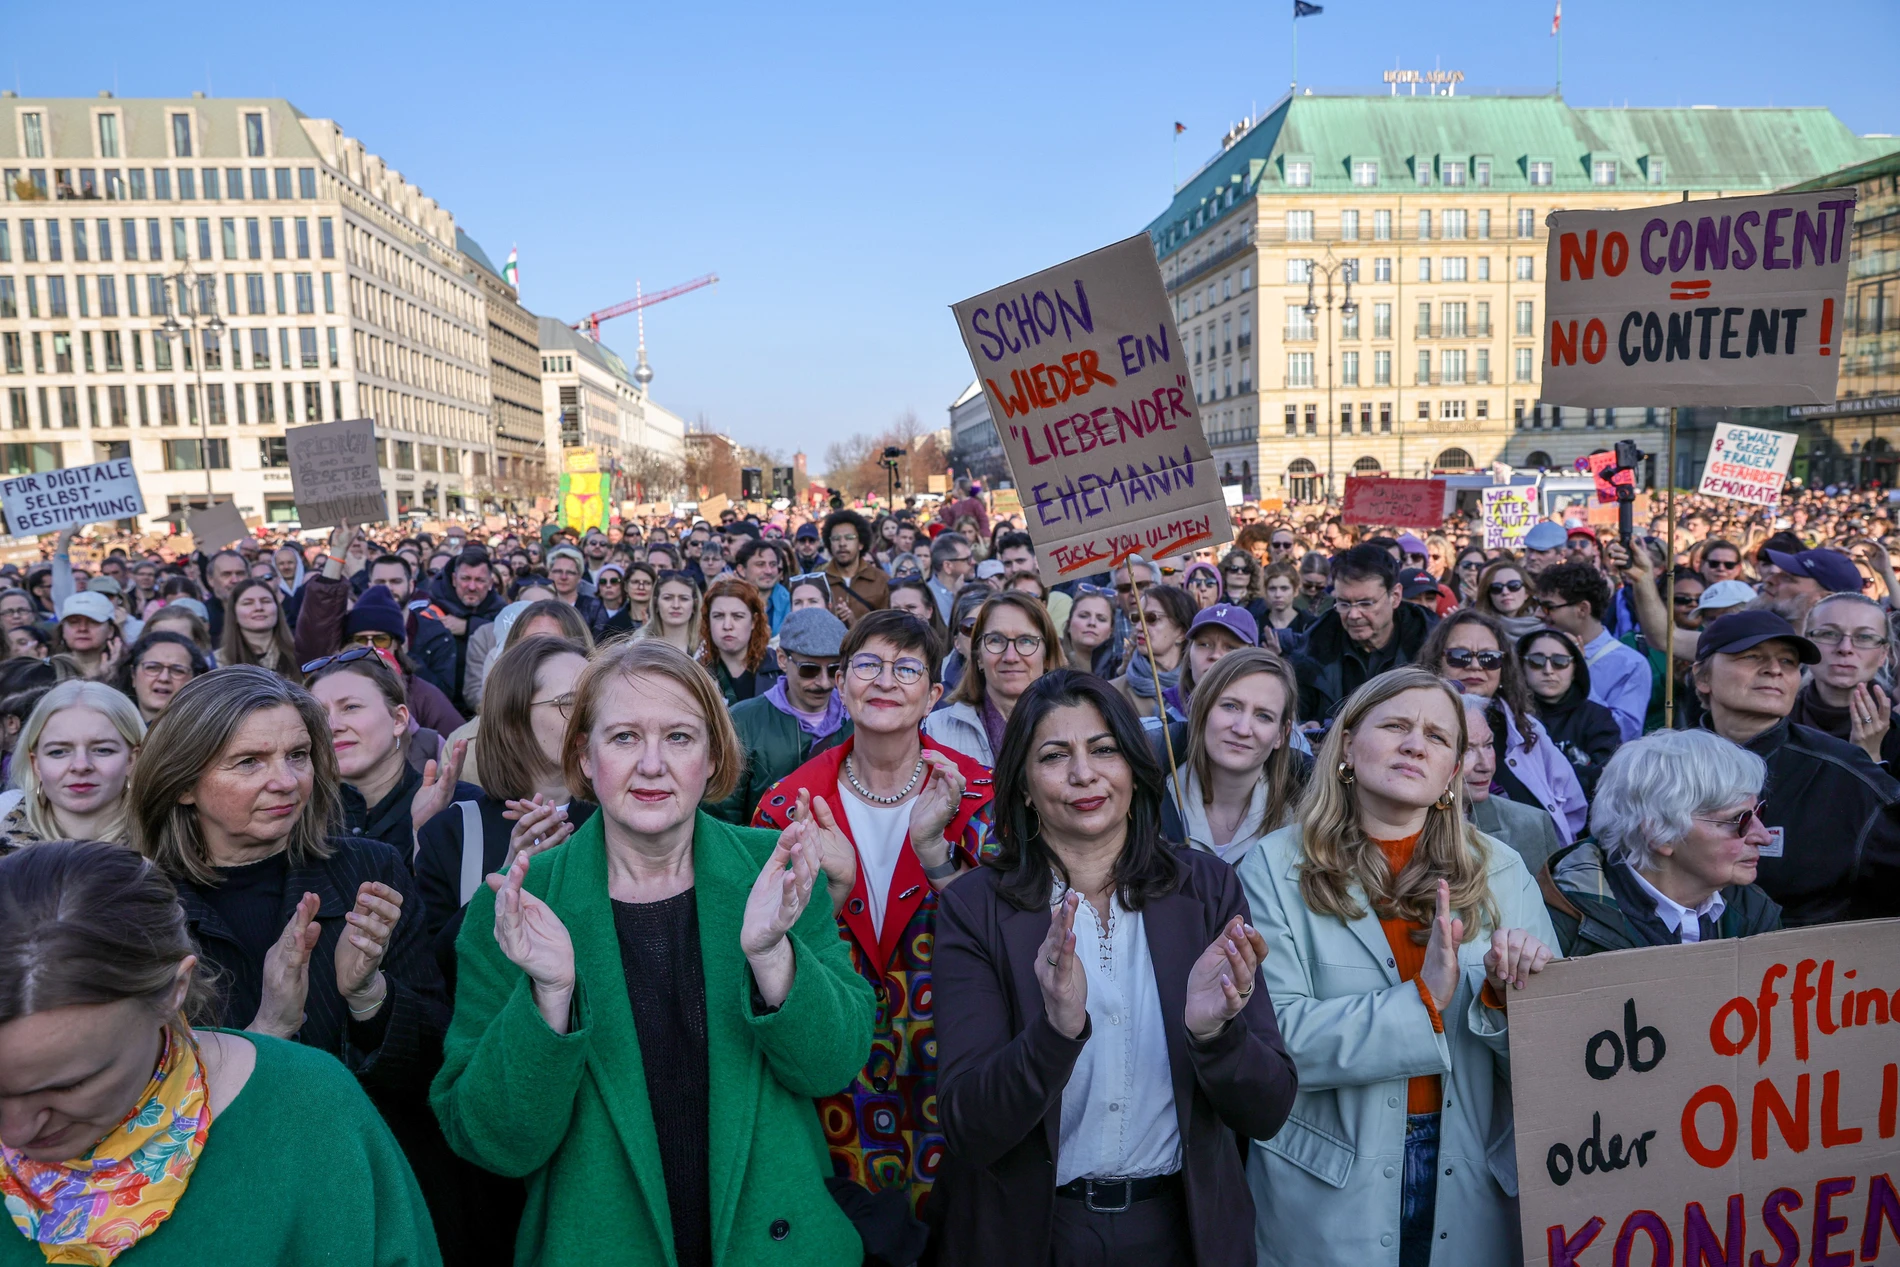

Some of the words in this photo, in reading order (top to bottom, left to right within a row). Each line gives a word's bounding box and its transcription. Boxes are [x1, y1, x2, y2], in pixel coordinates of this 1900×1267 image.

[1560, 229, 1629, 281] NO
[1640, 200, 1857, 275] CONSENT
[972, 279, 1094, 362] SCHON
[1551, 318, 1607, 366] NO
[1618, 307, 1808, 366] CONTENT
[986, 349, 1118, 419] WIEDER
[1117, 323, 1170, 376] EIN
[1009, 374, 1192, 465] "LIEBENDER"
[1728, 429, 1781, 447] GEWALT
[1724, 450, 1775, 468] FRAUEN
[1736, 442, 1779, 457] GEGEN
[4, 477, 41, 497] FÜR
[46, 461, 132, 489] DIGITALE
[301, 464, 372, 488] GESETZE
[1031, 444, 1194, 526] EHEMANN
[1391, 485, 1409, 501] bin
[1487, 490, 1515, 502] WER
[17, 494, 137, 530] BESTIMMUNG
[1488, 528, 1503, 537] IST
[1050, 541, 1096, 568] FUCK
[1107, 534, 1140, 558] YOU
[1145, 515, 1210, 548] ULMEN
[1584, 997, 1667, 1081] ob
[1546, 1110, 1657, 1187] oder
[1681, 1062, 1899, 1169] ONLI
